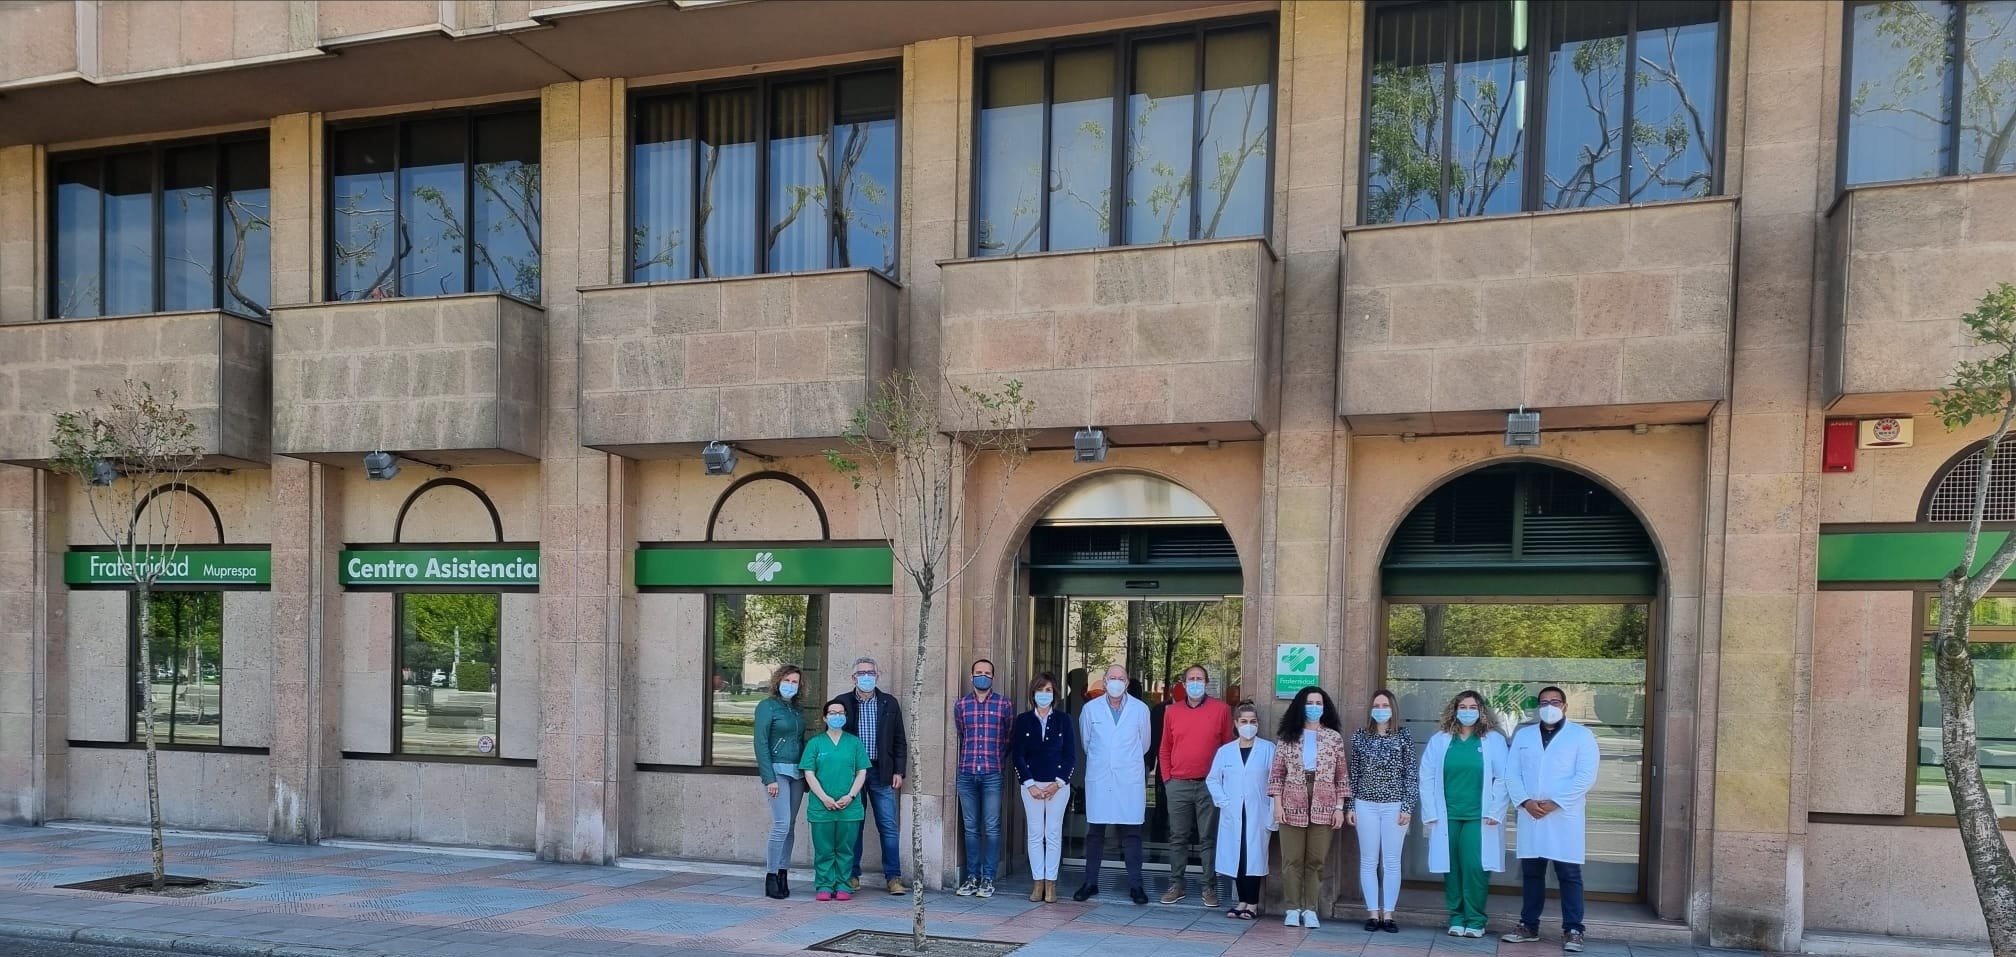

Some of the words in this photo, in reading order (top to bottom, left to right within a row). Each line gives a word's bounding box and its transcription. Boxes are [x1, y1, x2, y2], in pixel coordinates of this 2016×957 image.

[203, 564, 257, 579] Muprespa
[347, 557, 419, 578] Centro
[424, 556, 541, 578] Asistencia
